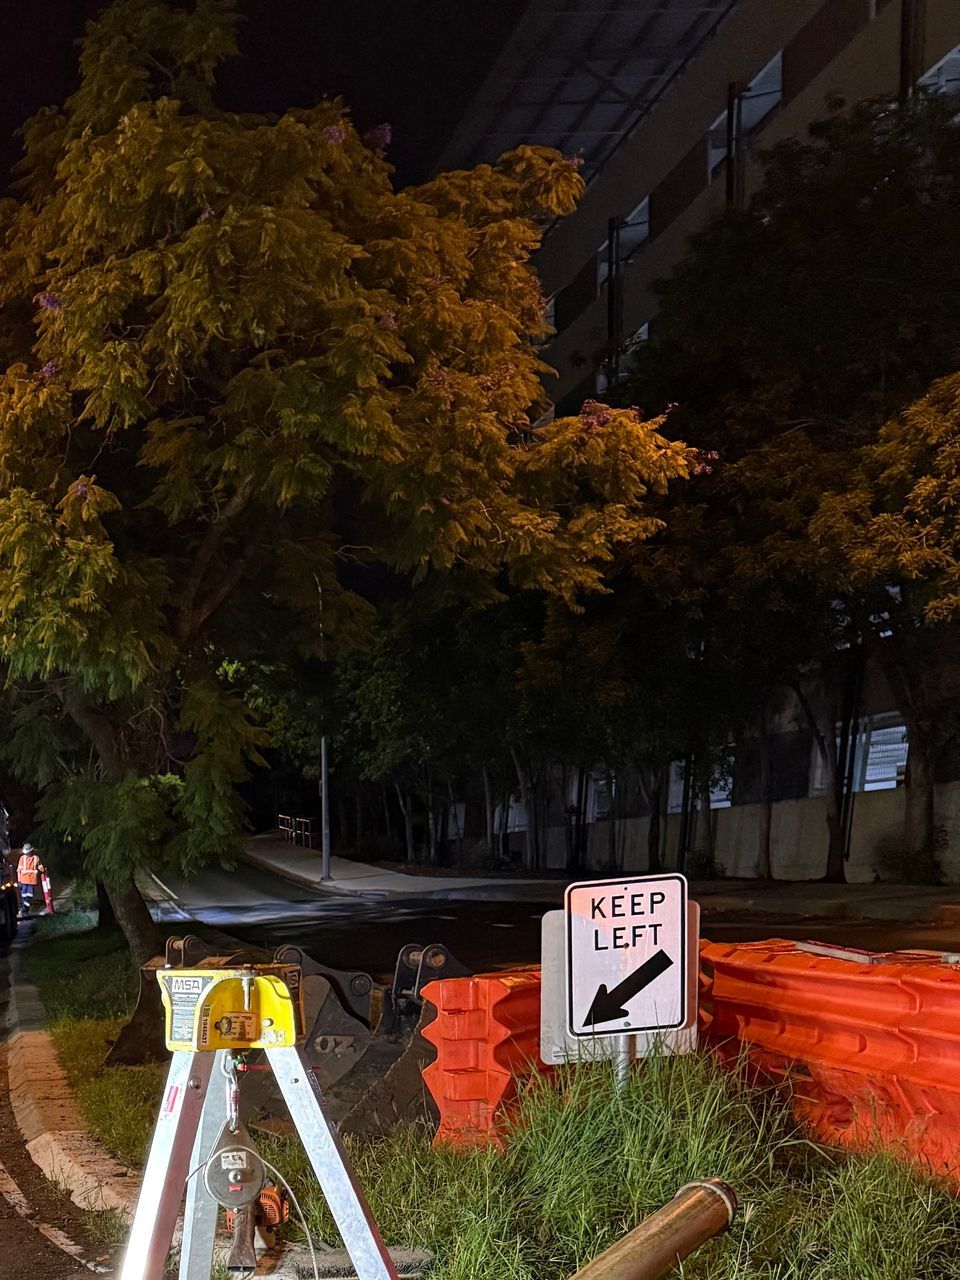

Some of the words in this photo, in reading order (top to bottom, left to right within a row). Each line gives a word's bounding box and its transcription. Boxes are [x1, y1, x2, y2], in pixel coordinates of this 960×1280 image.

[591, 891, 666, 920] KEEP
[594, 923, 663, 951] LEFT
[174, 979, 200, 991] MSA
